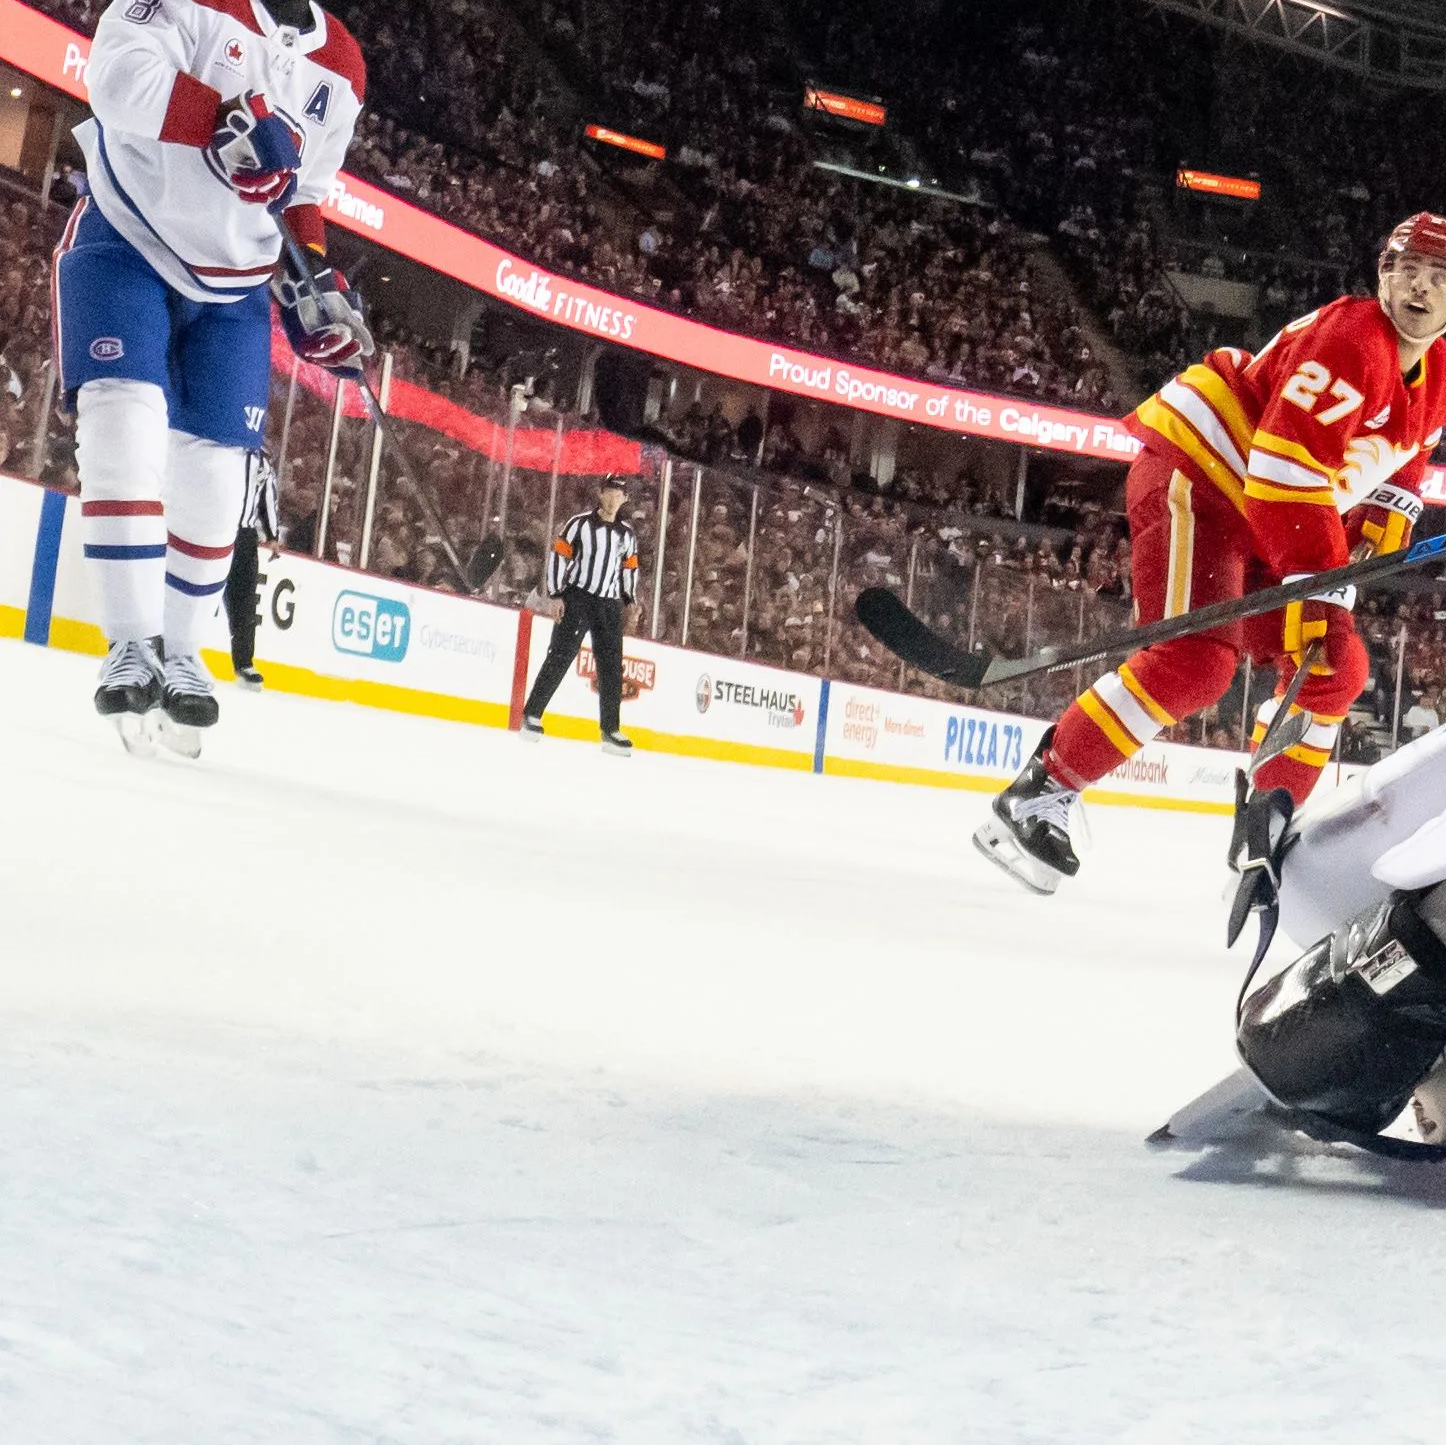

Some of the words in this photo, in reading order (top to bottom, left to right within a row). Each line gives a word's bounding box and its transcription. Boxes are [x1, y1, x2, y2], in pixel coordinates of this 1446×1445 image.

[301, 81, 333, 127] A
[327, 178, 385, 231] Flames
[553, 292, 636, 340] FITNESS
[769, 353, 831, 391] Proud
[835, 369, 918, 411] Sponsor
[926, 395, 949, 417] of
[951, 398, 992, 426] the
[999, 405, 1089, 450] Calgary
[1092, 424, 1144, 455] Flam
[1280, 360, 1366, 427] 27
[714, 680, 797, 713] STEELHAUS
[846, 696, 877, 724] direct
[843, 719, 878, 749] energy
[944, 716, 998, 769] PIZZA
[1001, 724, 1023, 771] 73
